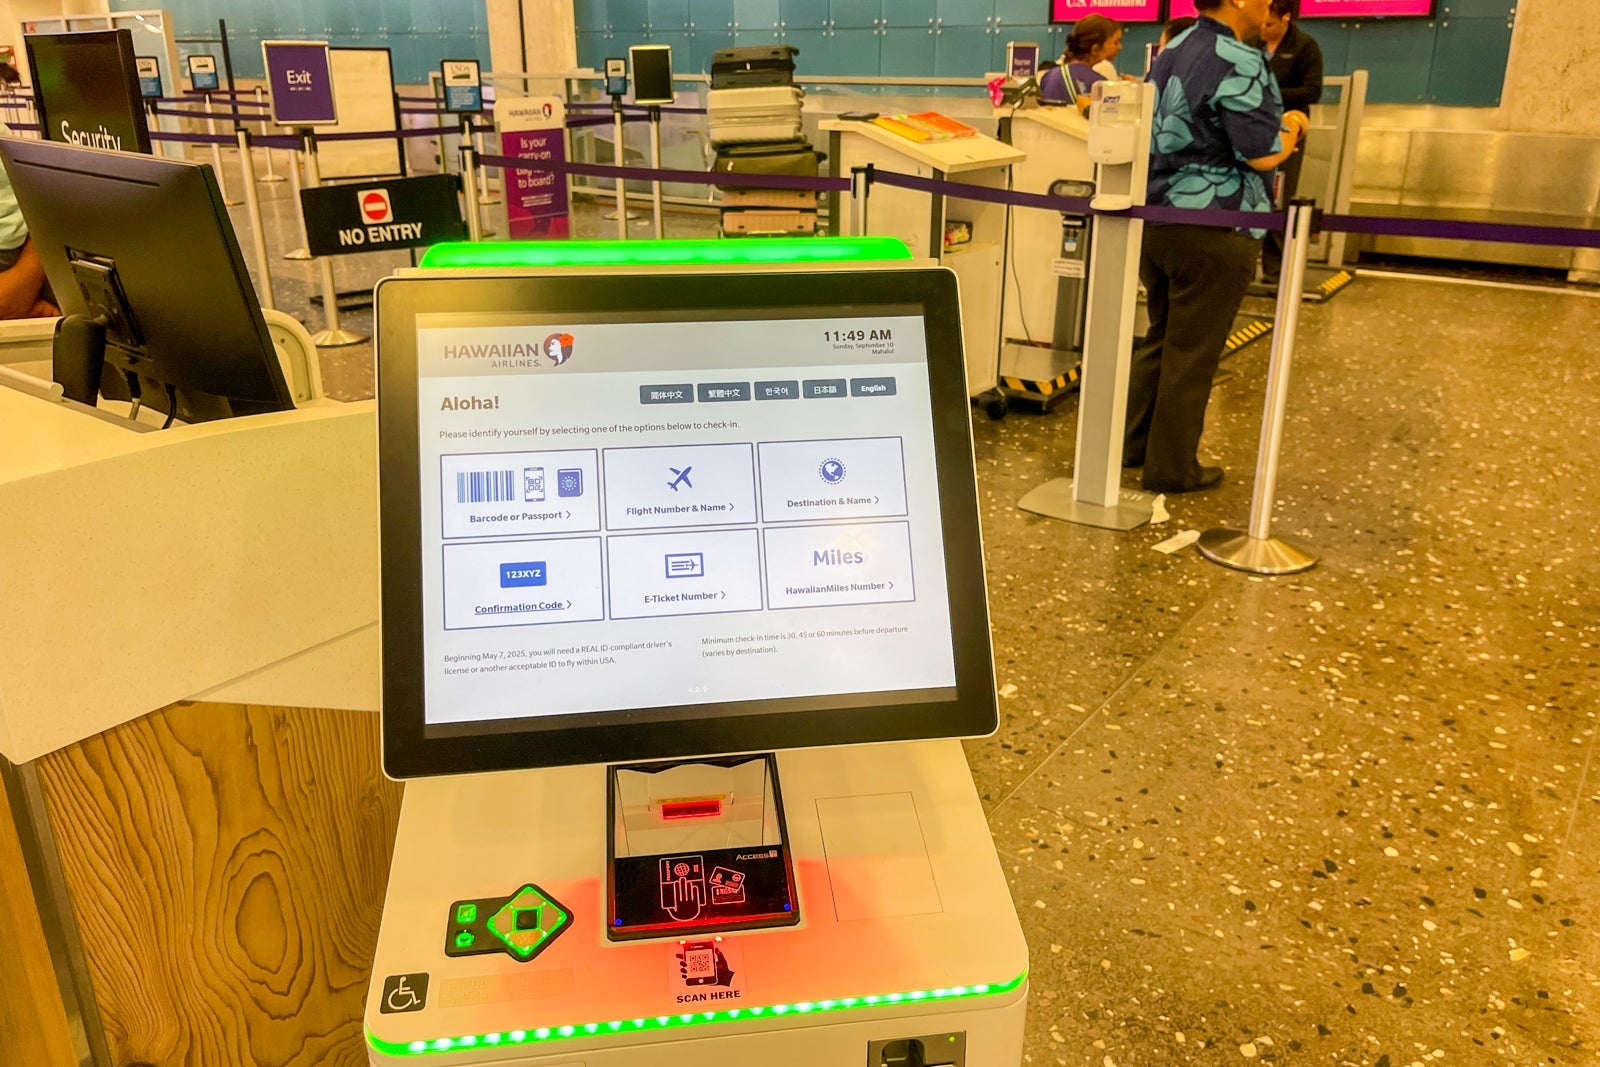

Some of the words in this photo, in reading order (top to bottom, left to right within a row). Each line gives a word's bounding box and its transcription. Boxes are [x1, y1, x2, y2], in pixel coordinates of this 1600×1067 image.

[286, 69, 312, 85] Exit
[61, 120, 121, 151] Security
[520, 137, 528, 149] Is
[529, 137, 547, 150] your
[518, 179, 527, 189] to
[528, 172, 555, 188] board?
[338, 228, 365, 246] NO
[367, 222, 423, 244] ENTRY
[823, 330, 865, 342] 11:49
[869, 329, 892, 341] AM
[443, 342, 540, 360] HAWAIIAN
[832, 342, 855, 350] Sunday,
[855, 341, 885, 349] September
[765, 386, 789, 396] 한국어
[813, 385, 837, 395] 日本語
[861, 383, 887, 394] English
[440, 394, 500, 412] Aloha!
[439, 428, 468, 439] Please
[469, 427, 501, 439] identify
[503, 426, 538, 438] yourself
[539, 426, 550, 437] by
[551, 425, 590, 436] selecting
[591, 425, 608, 433] one
[608, 424, 618, 433] of
[618, 423, 633, 432] the
[633, 422, 665, 433] options
[666, 421, 692, 431] below
[693, 421, 702, 430] to
[703, 419, 740, 430] check-in.
[626, 504, 653, 517] Flight
[654, 503, 691, 514] Number
[692, 504, 699, 512] &
[700, 502, 726, 513] Name
[787, 497, 837, 509] Destination
[838, 498, 845, 506] &
[846, 496, 872, 505] Name
[470, 513, 509, 524] Barcode
[510, 514, 520, 522] or
[521, 510, 563, 522] Passport
[813, 548, 864, 567] Miles
[505, 569, 542, 580] 123XYZ
[785, 583, 849, 596] HawaiianMiles
[850, 581, 886, 592] Number
[644, 592, 680, 604] E-Ticket
[681, 590, 718, 602] Number
[474, 602, 537, 614] Confirmation
[538, 600, 563, 611] Code
[702, 636, 735, 646] Minimum
[735, 634, 764, 644] check-in
[765, 633, 780, 642] time
[781, 633, 787, 641] is
[787, 632, 798, 641] 30,
[799, 631, 808, 639] 45
[809, 631, 816, 639] or
[817, 630, 826, 638] 60
[826, 628, 853, 638] minutes
[854, 627, 875, 636] before
[876, 625, 909, 636] departure
[444, 652, 481, 664] Beginning
[482, 652, 498, 662] May
[499, 651, 506, 660] 7,
[507, 650, 528, 659] 2025,
[529, 650, 542, 659] you
[543, 647, 556, 656] will
[557, 646, 575, 655] need
[582, 645, 599, 654] REAL
[600, 642, 645, 653] ID-compliant
[646, 640, 673, 649] driver's
[703, 648, 725, 659] (varies
[726, 648, 735, 658] by
[736, 646, 778, 656] destination).
[444, 666, 470, 676] license
[471, 666, 479, 674] or
[480, 663, 508, 674] another
[509, 661, 548, 672] acceptable
[549, 661, 557, 669] ID
[567, 659, 575, 669] fly
[577, 657, 599, 667] within
[600, 656, 617, 665] USA.
[676, 993, 707, 1004] SCAN
[710, 990, 741, 1000] HERE
